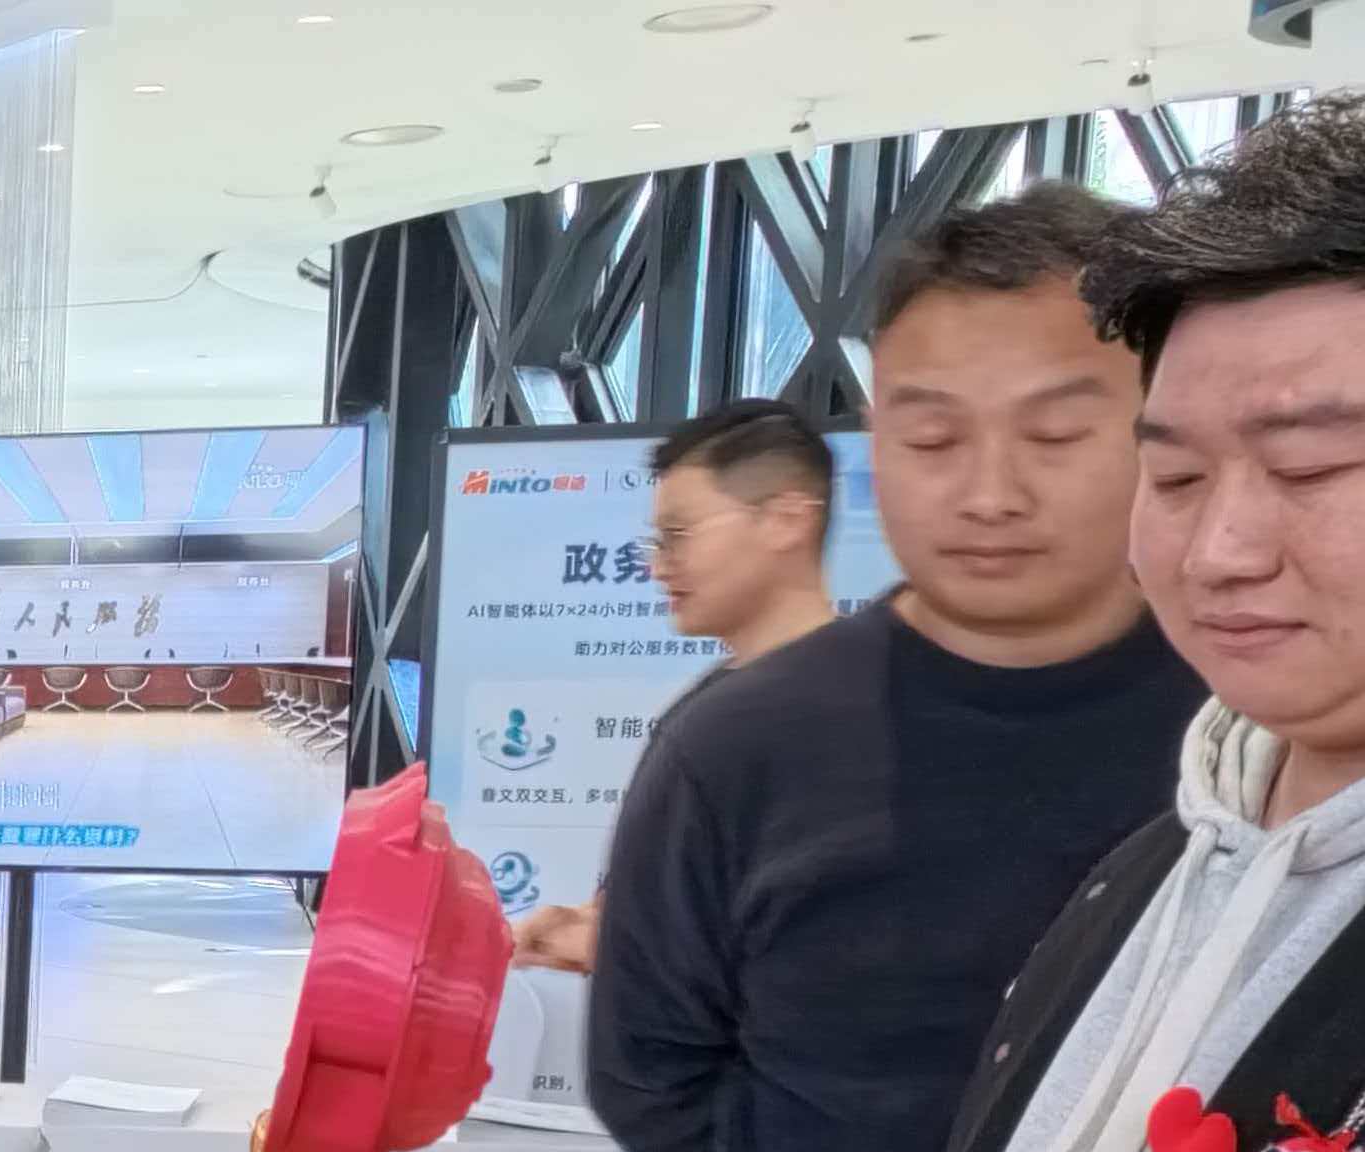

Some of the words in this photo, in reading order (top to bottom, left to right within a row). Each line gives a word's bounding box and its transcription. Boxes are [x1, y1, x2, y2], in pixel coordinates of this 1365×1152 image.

[467, 601, 678, 619] AI智能体以7×24小时智能
